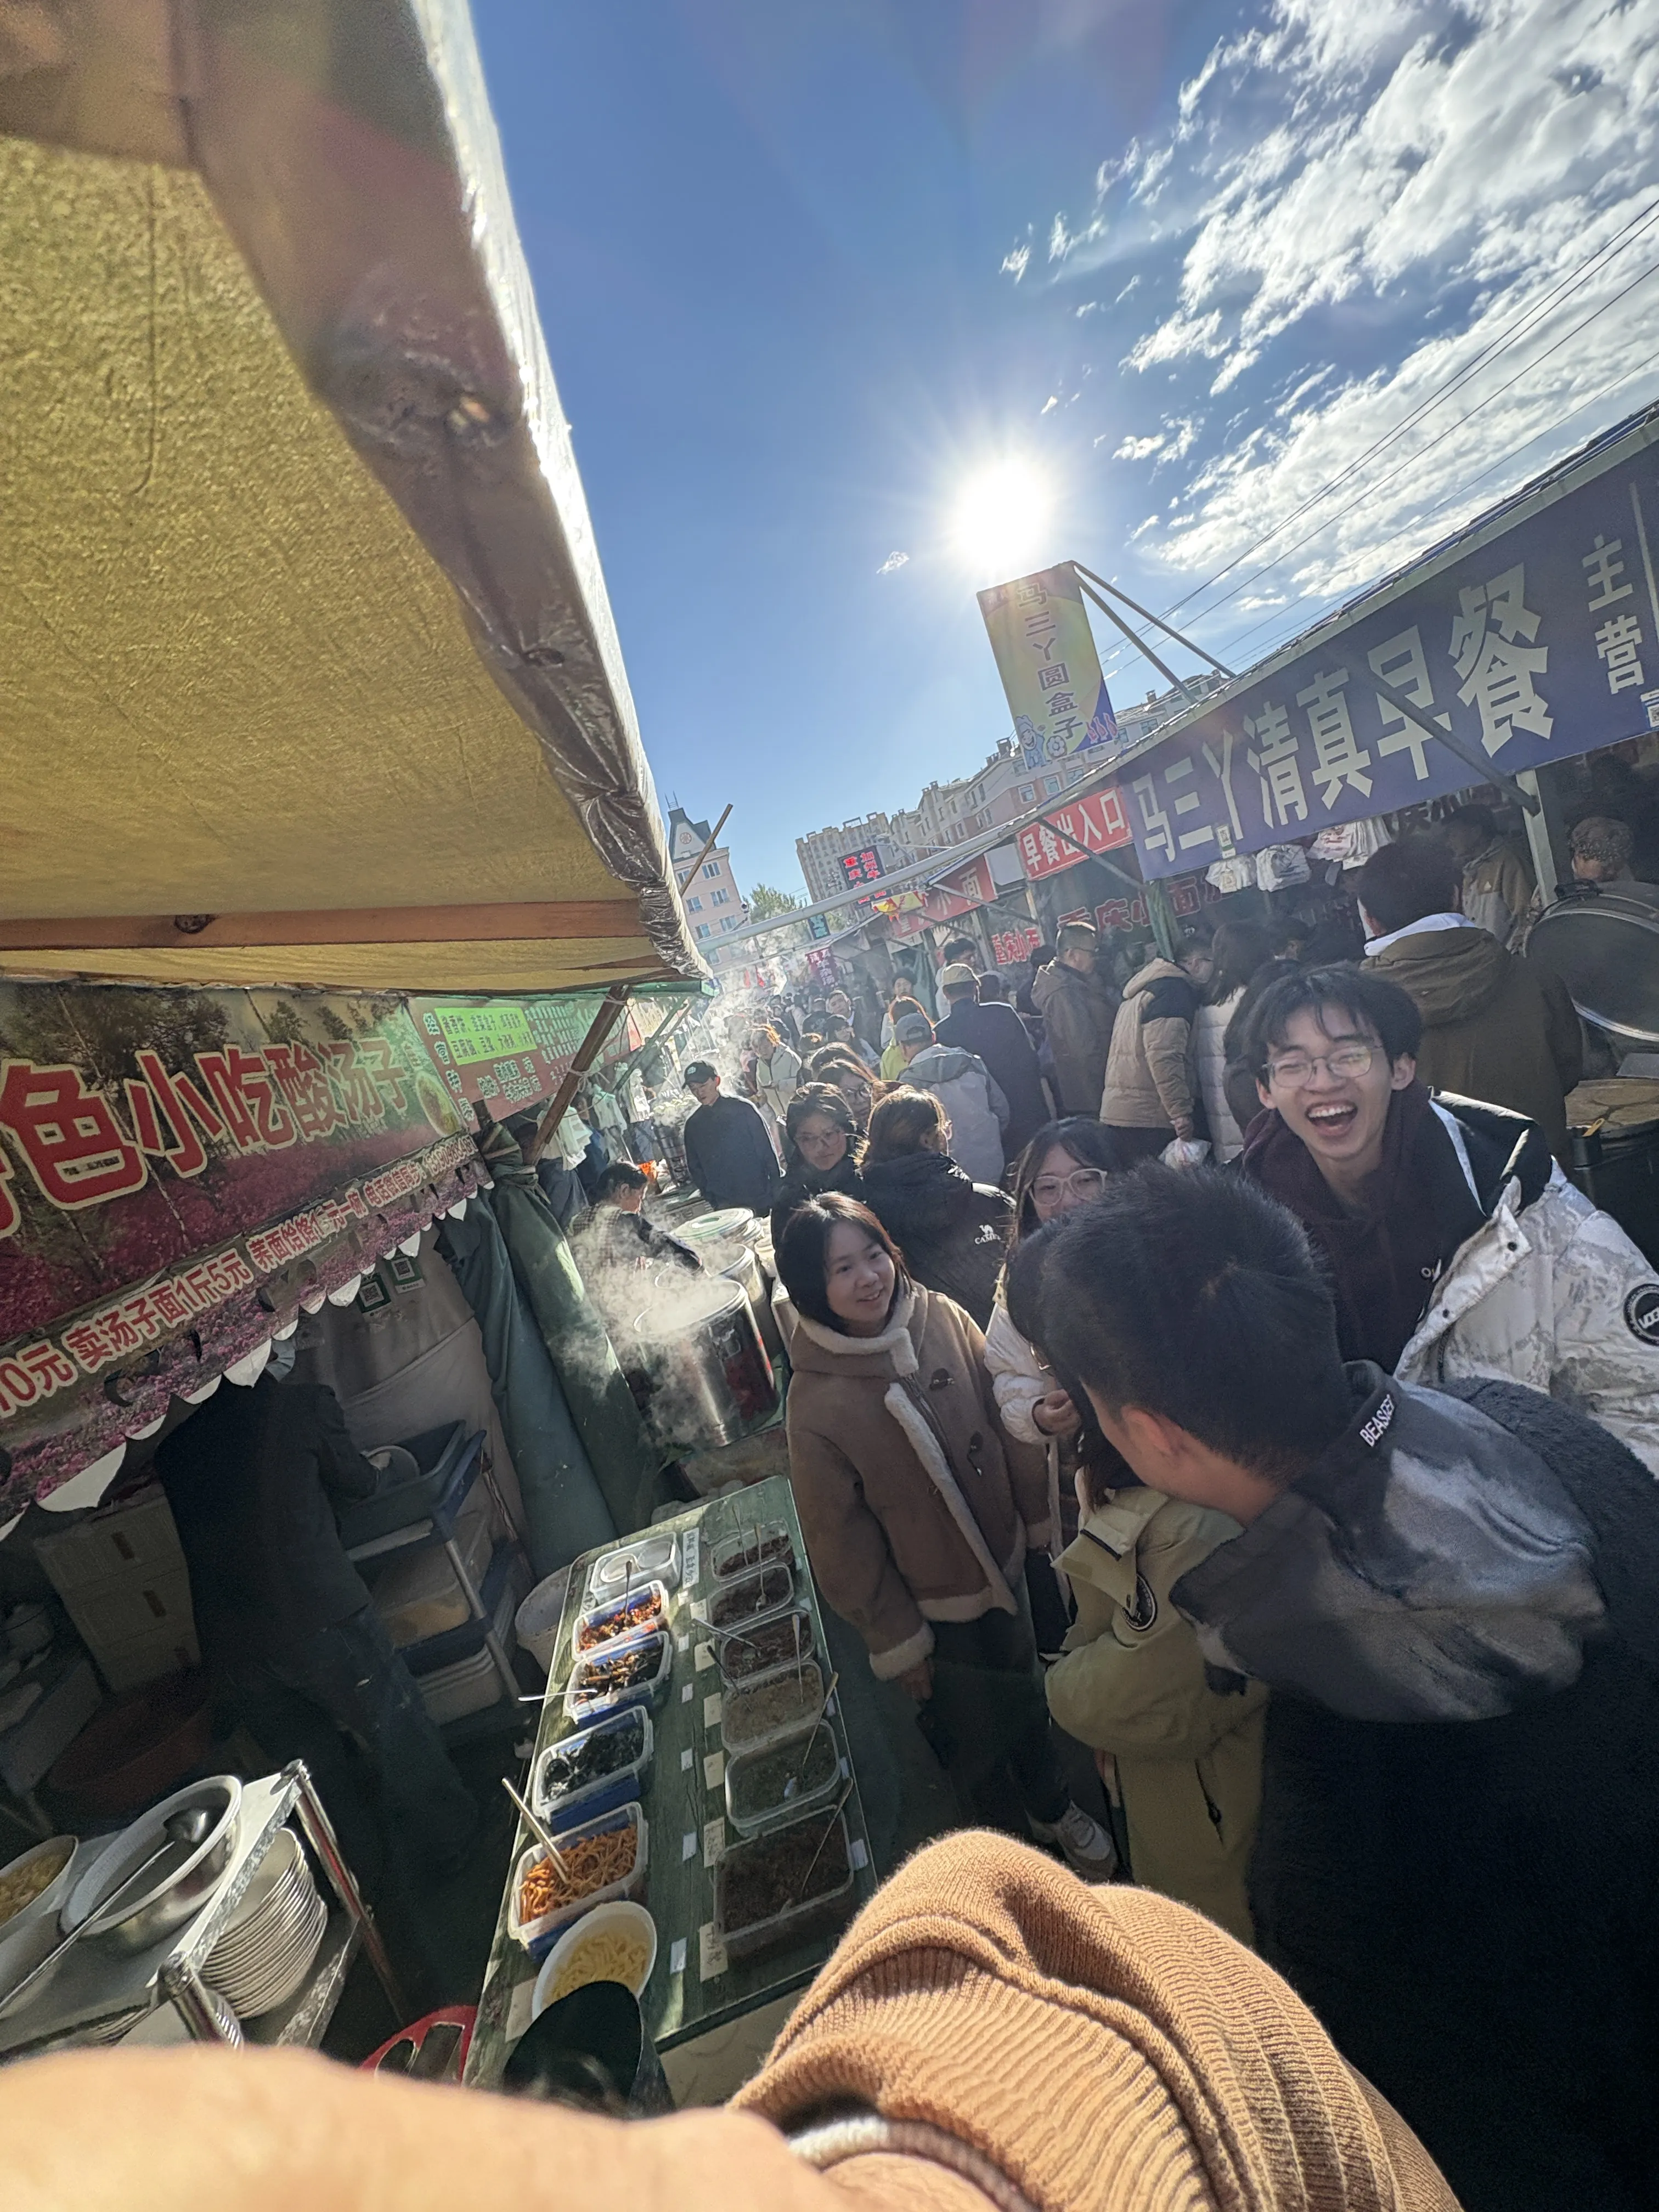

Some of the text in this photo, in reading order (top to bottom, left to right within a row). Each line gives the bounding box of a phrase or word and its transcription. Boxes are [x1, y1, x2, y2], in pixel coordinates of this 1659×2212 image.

[1017, 582, 1084, 741] 马三丫圆盒子
[1582, 534, 1644, 695] 主营
[1131, 562, 1554, 863] 马三丫清真早餐
[1022, 790, 1125, 872] 早餐出入口
[62, 1251, 253, 1372] 卖汤子面1斤5元
[245, 1187, 369, 1274] 荞面饸饹1元一碗
